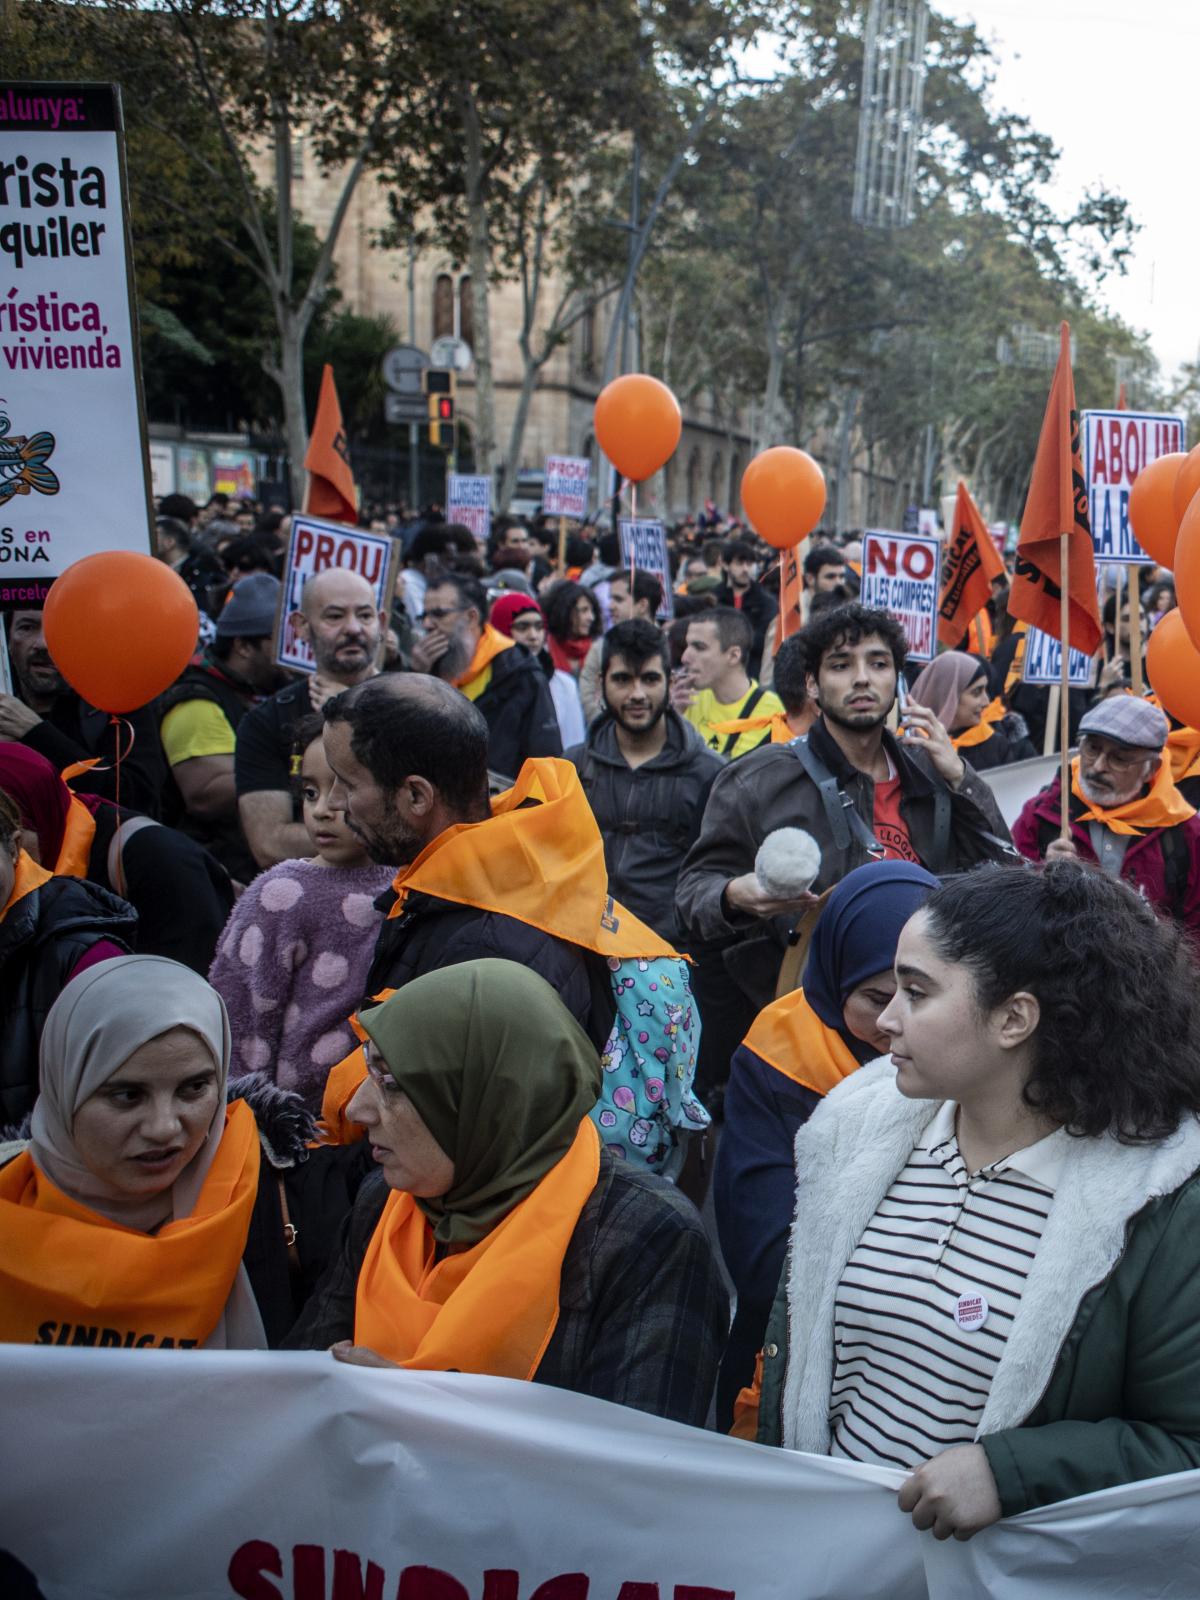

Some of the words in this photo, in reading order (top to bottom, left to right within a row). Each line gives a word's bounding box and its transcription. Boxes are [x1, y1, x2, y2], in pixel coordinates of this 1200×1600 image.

[0, 215, 106, 268] quiler
[2, 335, 121, 369] vivienda
[24, 530, 51, 543] en
[294, 530, 383, 586] PROU
[866, 539, 935, 581] NO
[865, 577, 873, 601] A
[874, 578, 890, 607] LES
[891, 579, 933, 613] COMPRES
